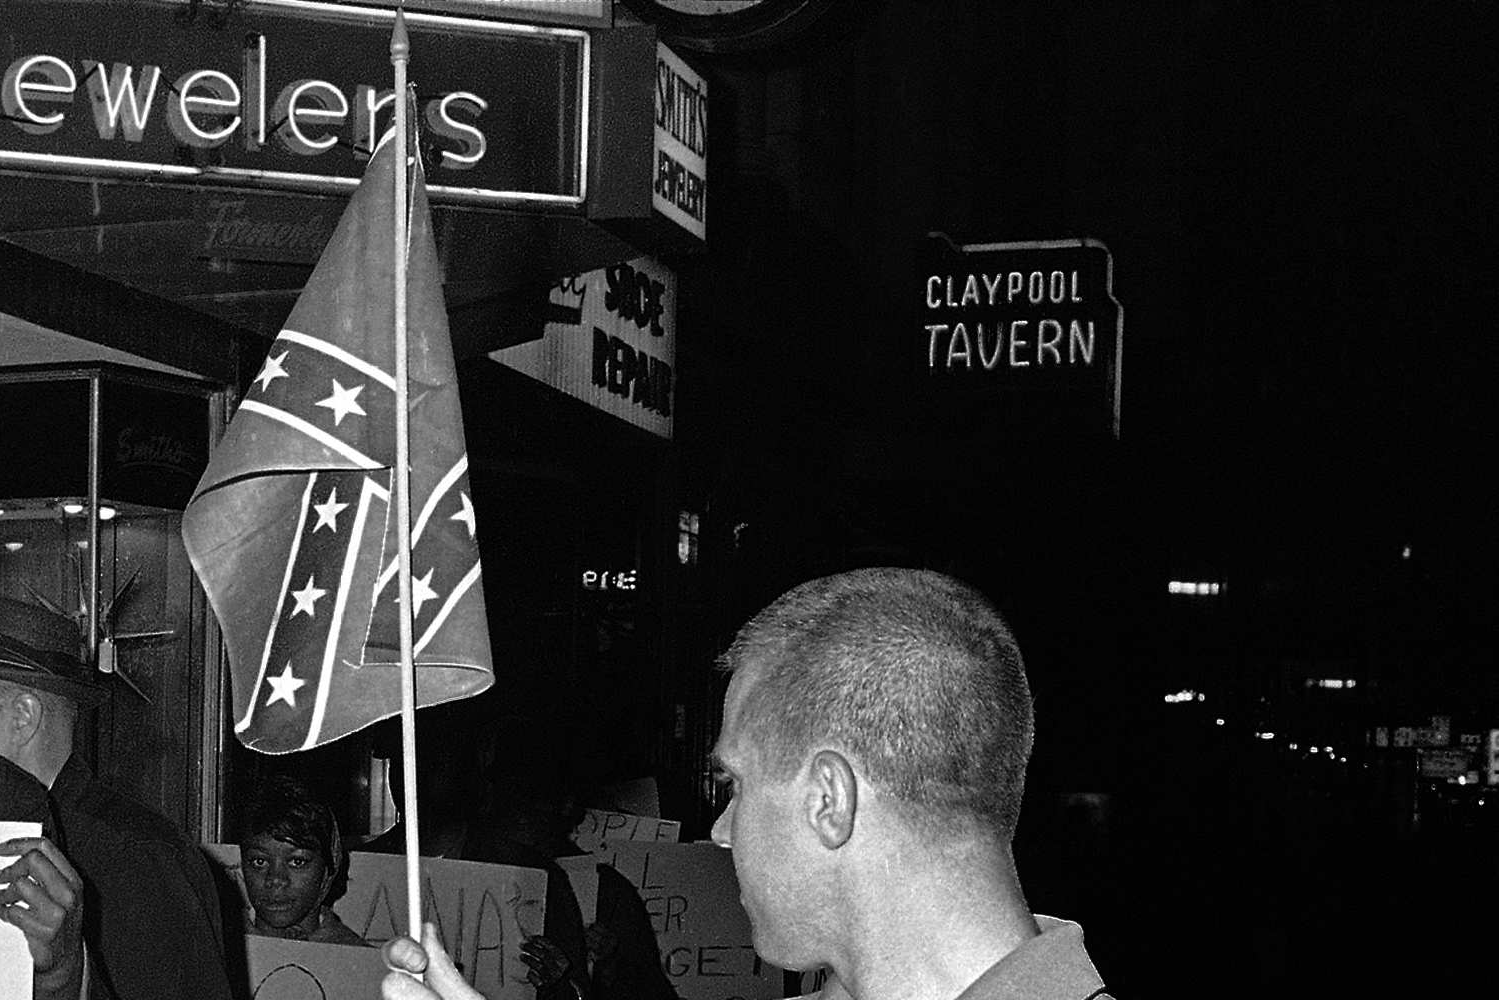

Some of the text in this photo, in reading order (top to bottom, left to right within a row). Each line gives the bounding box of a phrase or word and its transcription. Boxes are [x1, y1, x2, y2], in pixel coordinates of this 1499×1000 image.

[656, 57, 707, 159] SMITH'S
[605, 262, 665, 336] SHOE
[925, 269, 1083, 310] CLAYPOOL
[591, 326, 673, 418] REPAIR
[924, 319, 1096, 370] TAVERN
[665, 944, 764, 978] GET
